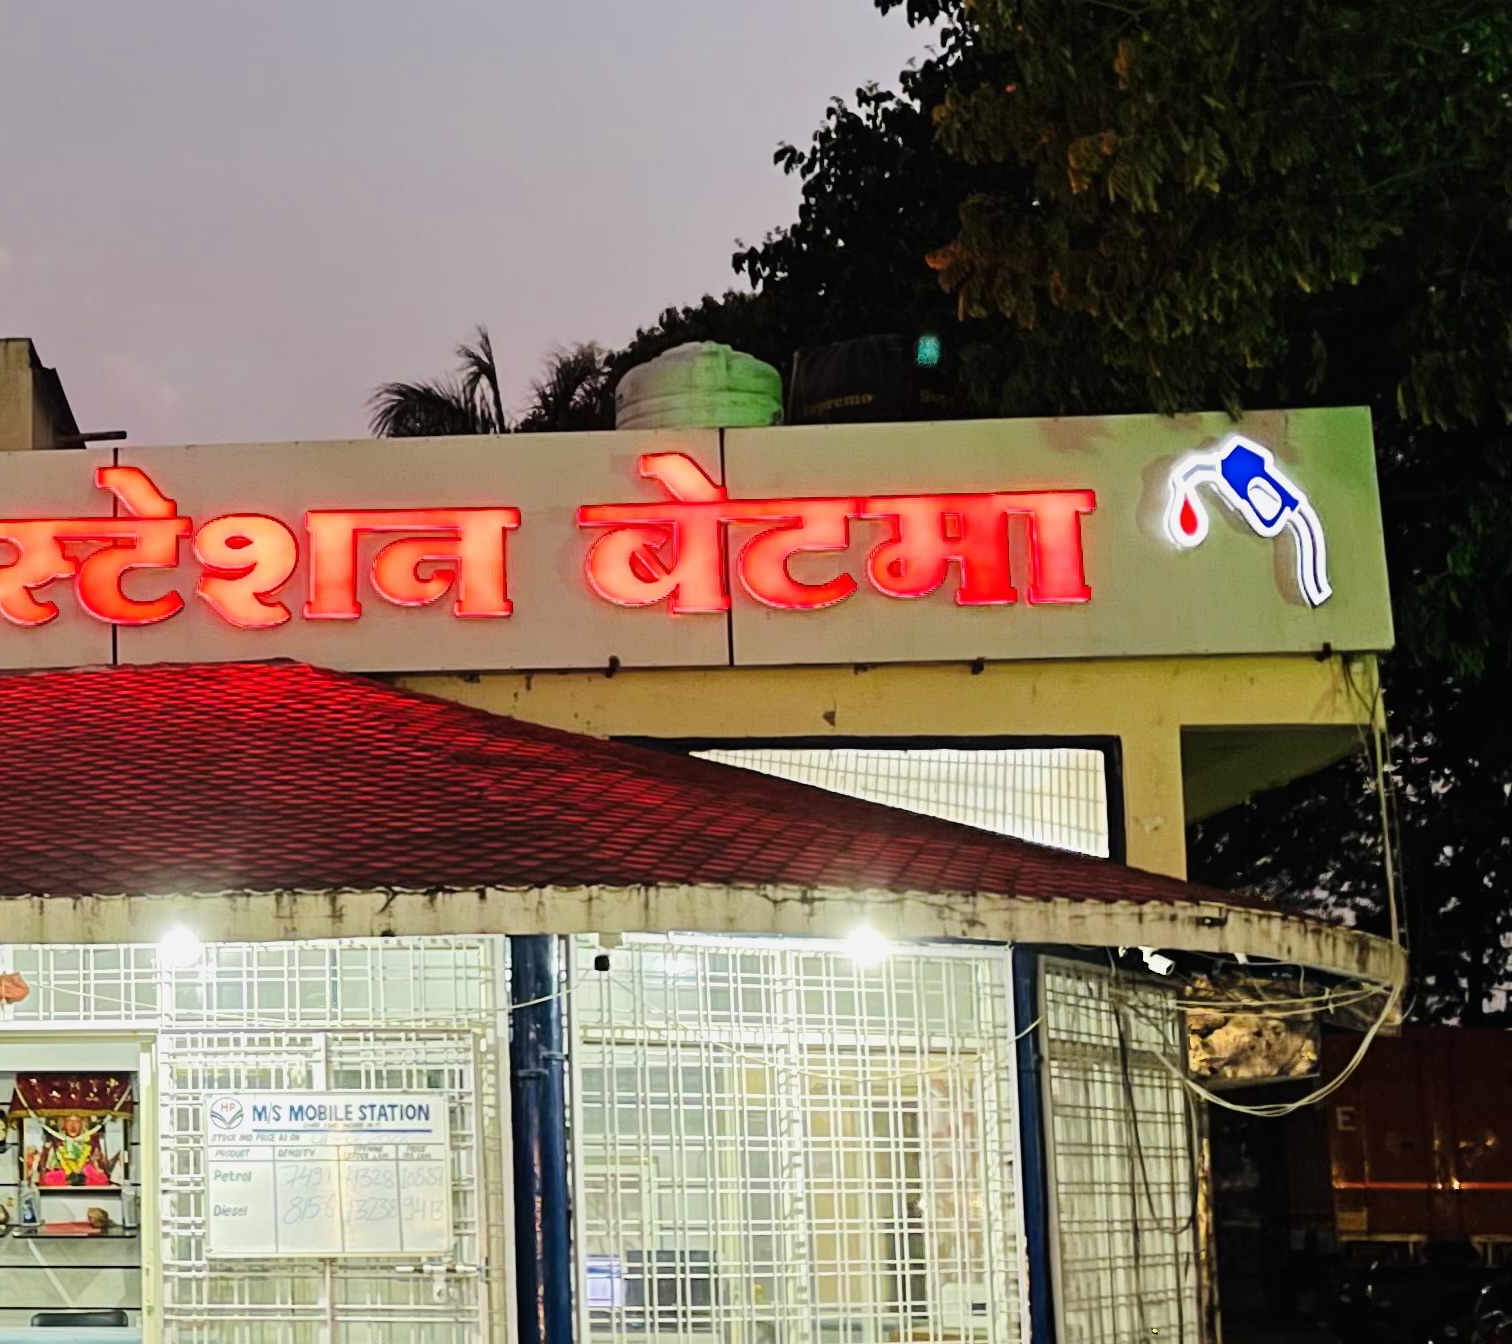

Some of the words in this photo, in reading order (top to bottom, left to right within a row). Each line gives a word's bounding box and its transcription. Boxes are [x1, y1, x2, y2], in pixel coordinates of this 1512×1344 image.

[577, 452, 1096, 614] बेटमा
[220, 1102, 236, 1112] HP
[289, 1104, 353, 1122] MOBILE
[358, 1104, 430, 1122] STATION
[211, 1134, 236, 1142] STOCK
[215, 1148, 251, 1158] PRODUCT
[278, 1148, 315, 1157] DENSITY
[214, 1169, 252, 1182] Petrol
[213, 1204, 248, 1217] Diesel
